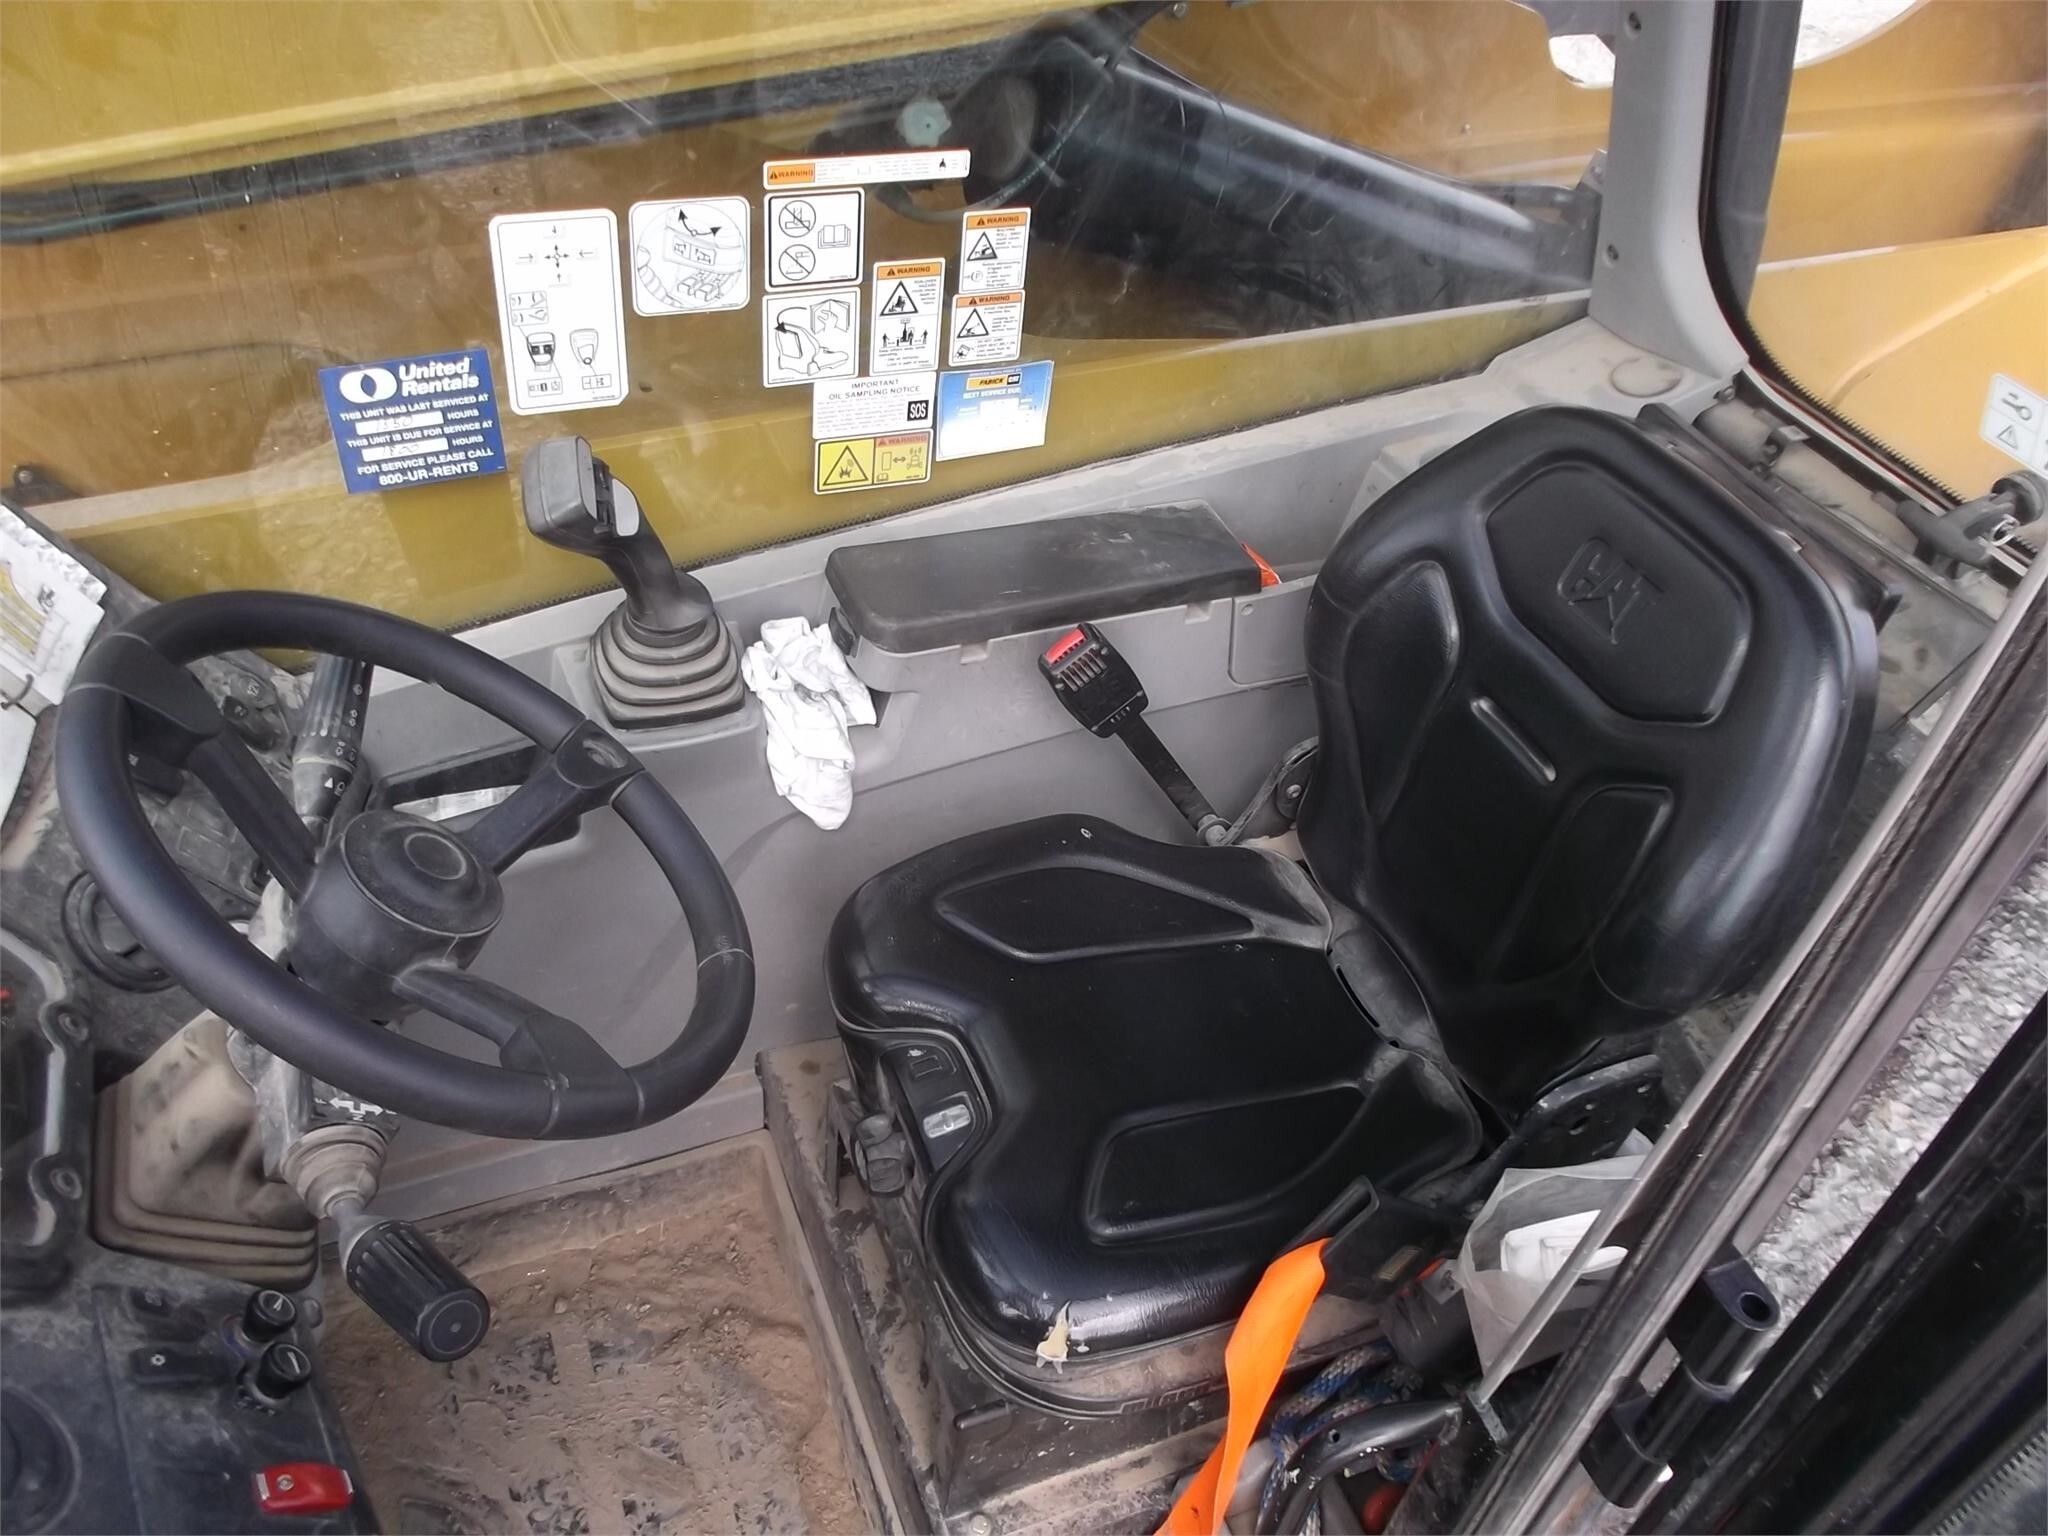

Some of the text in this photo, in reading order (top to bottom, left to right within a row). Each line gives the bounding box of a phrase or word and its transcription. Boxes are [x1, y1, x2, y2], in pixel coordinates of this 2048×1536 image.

[778, 169, 814, 178] WARNING
[987, 216, 1019, 224] WARNING
[897, 266, 931, 274] WARNING
[979, 295, 1010, 303] WARNING
[399, 357, 470, 381] United
[402, 374, 480, 397] Rentals
[851, 379, 899, 389] IMPORTANT
[829, 385, 920, 400] OIL SAMPLING NOTICE
[340, 393, 489, 421] THIS UNIT WAS LAST SERVICED AT
[447, 408, 479, 420] HOURS
[910, 403, 927, 418] SOS
[347, 419, 493, 448] THIS UNIT IS DUE FOR SERVICE AT
[452, 435, 484, 446] HOURS
[357, 446, 494, 475] FOR SERVICE PLEASE CALL
[379, 461, 479, 486] 800-UR-RENTS
